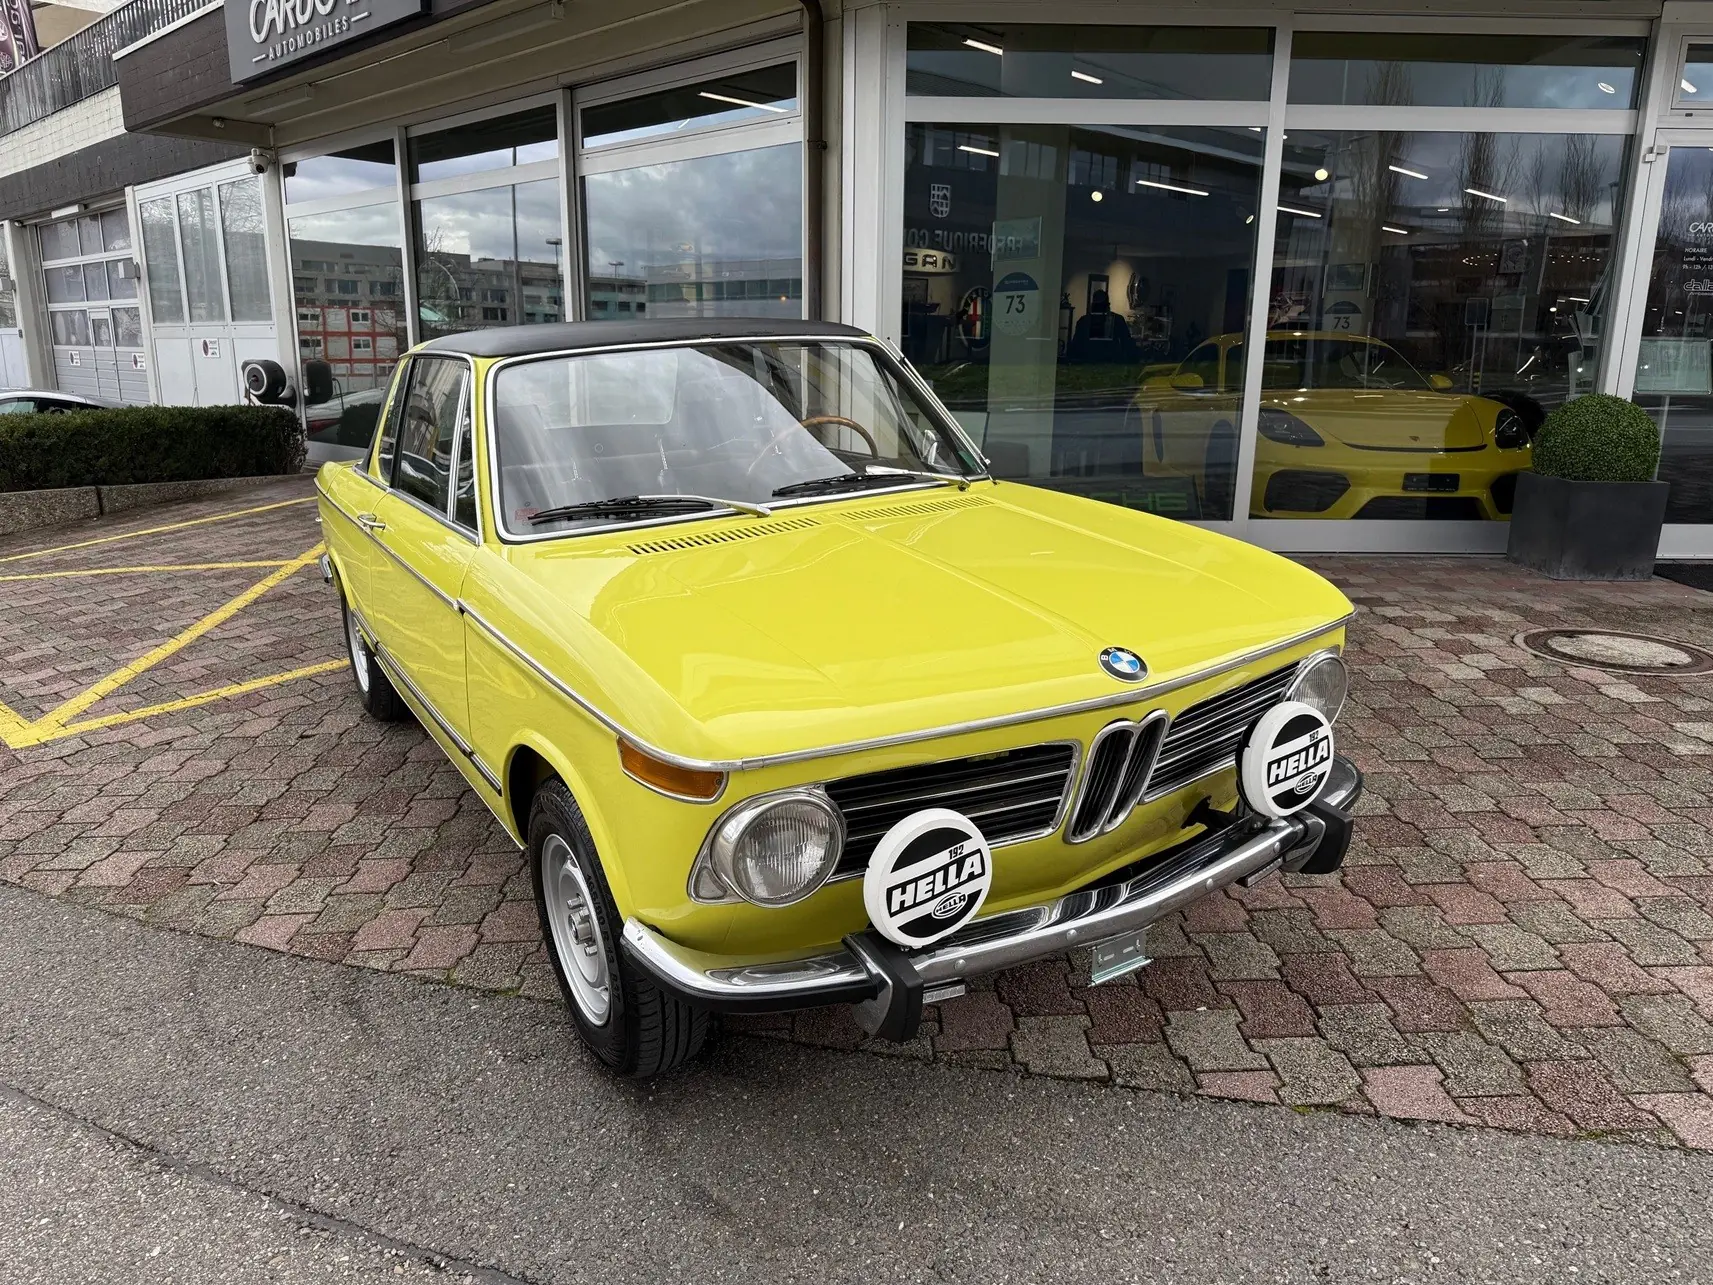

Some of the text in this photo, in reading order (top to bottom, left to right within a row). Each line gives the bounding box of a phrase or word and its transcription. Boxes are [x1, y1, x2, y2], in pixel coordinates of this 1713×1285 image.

[268, 15, 348, 61] AUTOMOBILES
[1689, 222, 1713, 233] CAR
[1005, 294, 1026, 314] 73
[1333, 316, 1351, 330] 73
[1309, 730, 1319, 743] 192
[1269, 739, 1329, 785] HELLA
[1297, 775, 1318, 789] HELLA
[948, 844, 964, 861] 192
[890, 853, 982, 913] HELLA
[935, 895, 966, 913] HELLA
